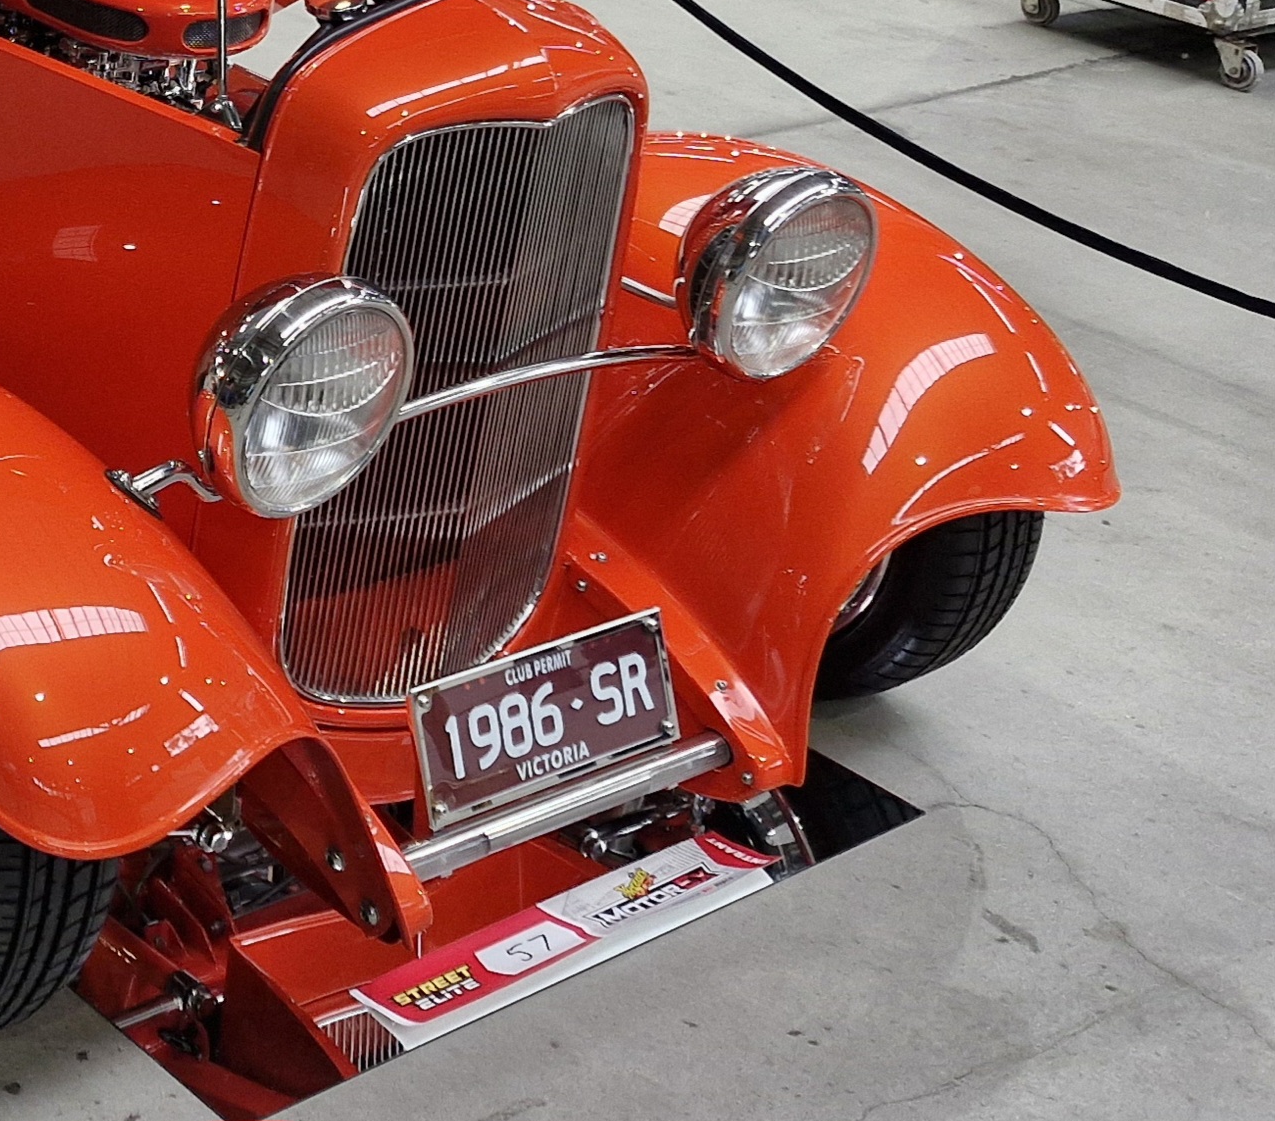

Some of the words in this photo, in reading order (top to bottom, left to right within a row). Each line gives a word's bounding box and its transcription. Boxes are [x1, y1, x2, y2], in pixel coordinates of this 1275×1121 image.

[505, 662, 533, 686] CLUB
[533, 649, 572, 678] PERMIT
[445, 681, 564, 780] 1986
[590, 652, 655, 726] SR
[516, 740, 590, 782] VICTORIA
[506, 933, 552, 962] 57
[393, 964, 472, 1007] STREET
[415, 977, 481, 1011] ELITE
